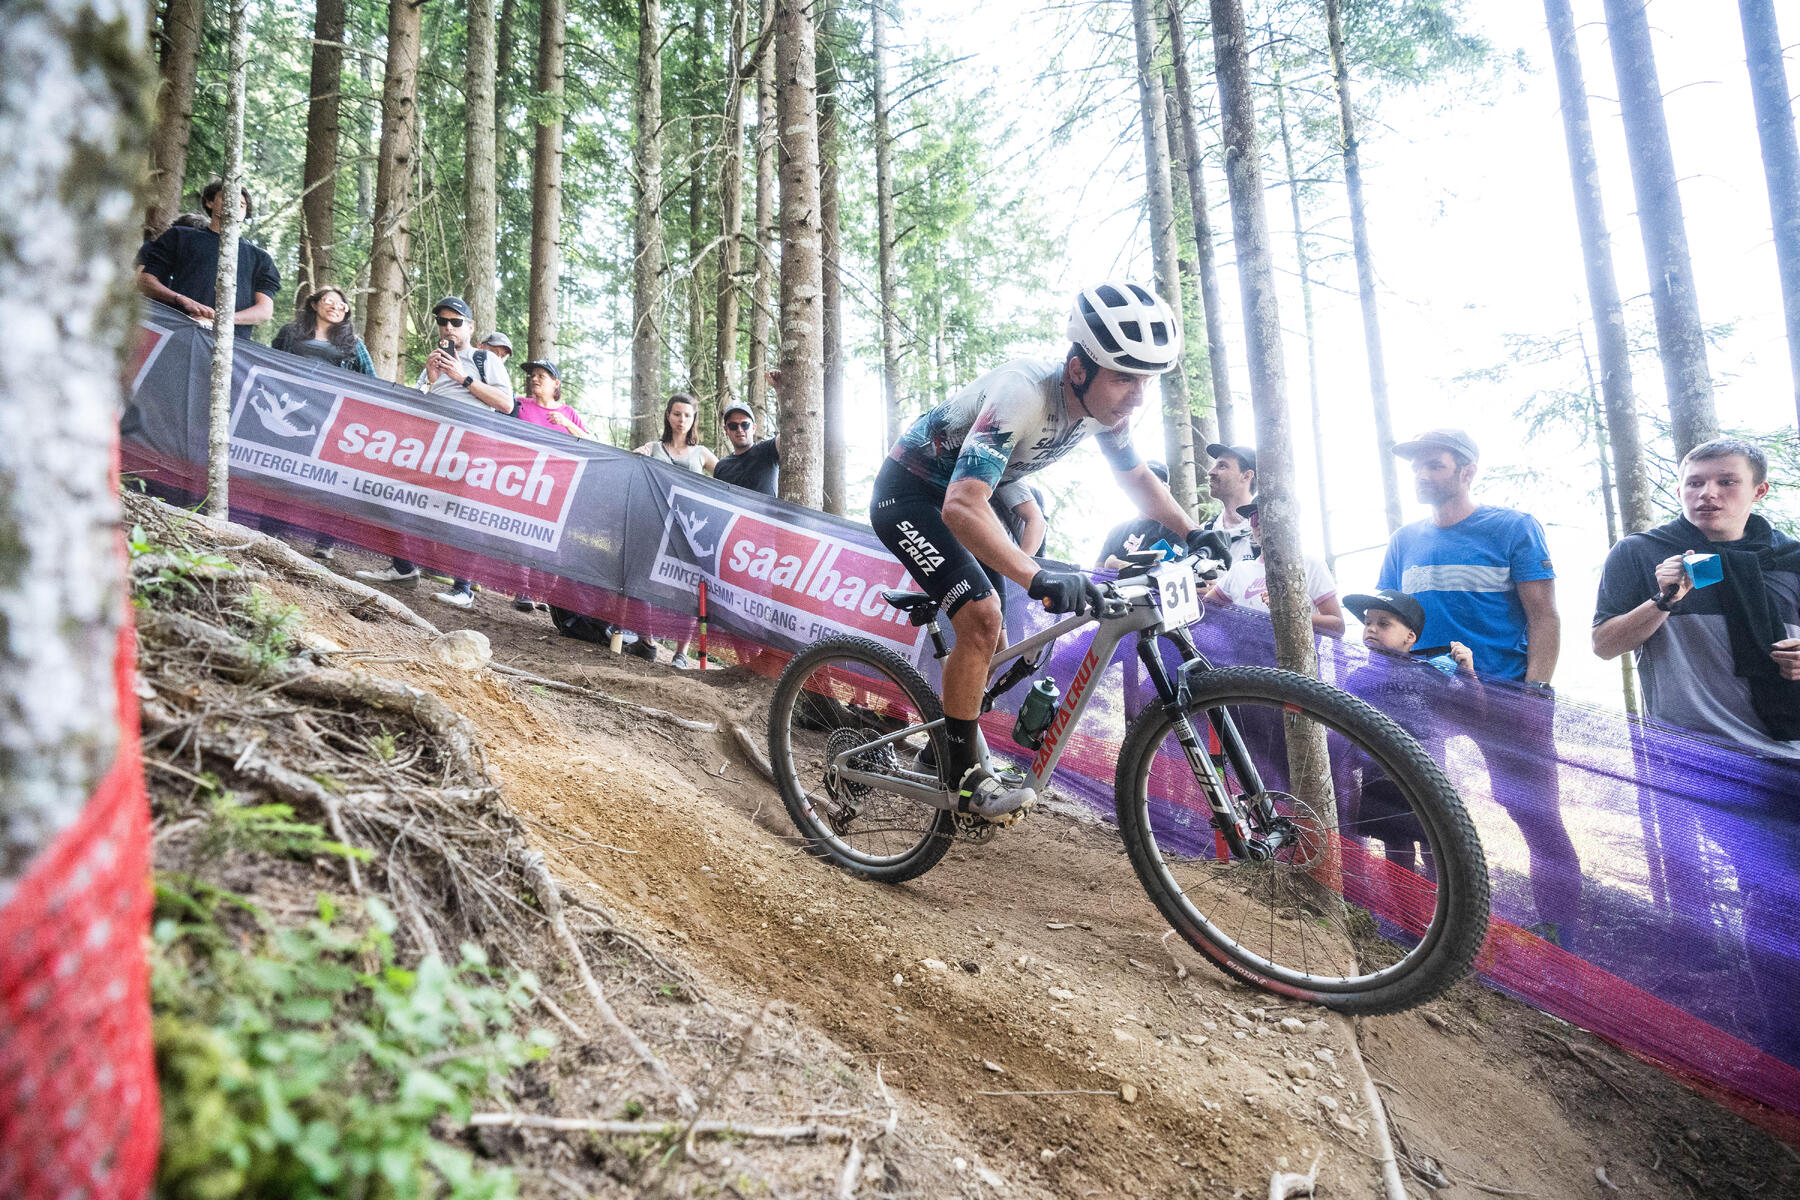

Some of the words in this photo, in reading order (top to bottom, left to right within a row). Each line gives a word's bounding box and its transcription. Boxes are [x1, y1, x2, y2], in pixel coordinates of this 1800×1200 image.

[337, 420, 555, 505] saalbach
[229, 444, 338, 486] HINTERGLEMM
[353, 477, 429, 509] LEOGANG
[444, 502, 554, 543] FIEBERBRUNN
[896, 521, 945, 568] SANTA
[898, 539, 936, 577] CRUZ
[744, 598, 797, 632] LEOGANG
[1165, 576, 1190, 609] 31
[1031, 707, 1072, 780] SANTA
[1065, 647, 1100, 711] CRUZ
